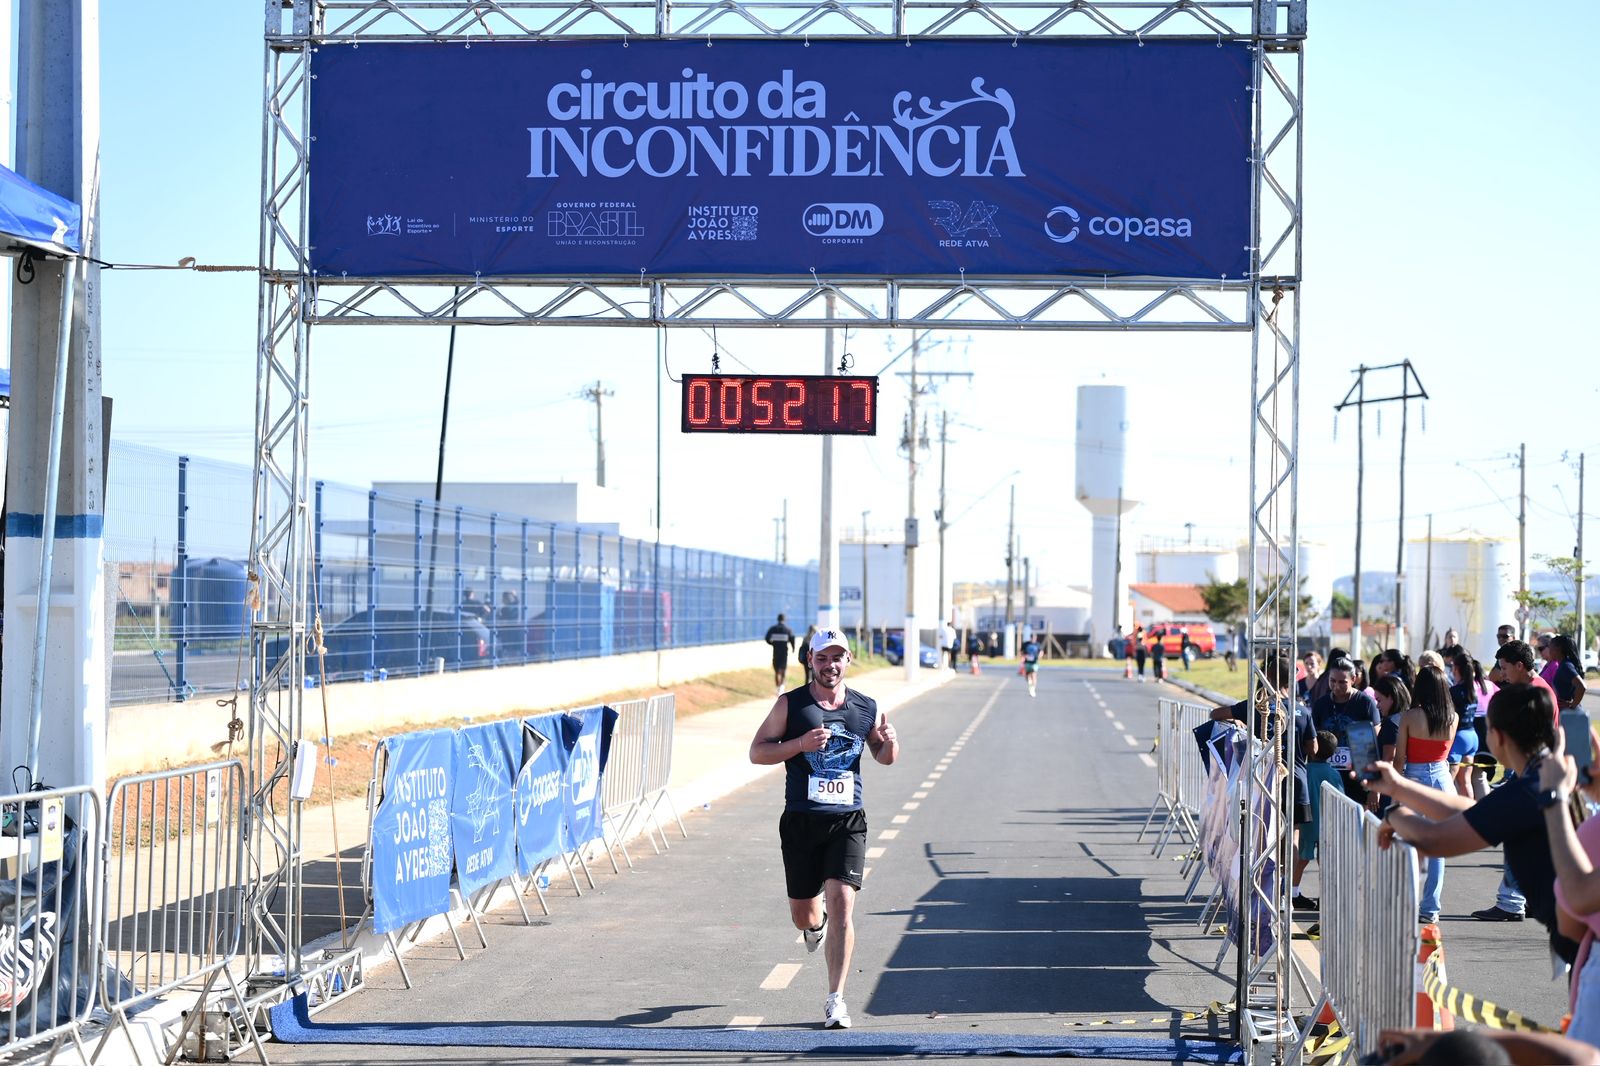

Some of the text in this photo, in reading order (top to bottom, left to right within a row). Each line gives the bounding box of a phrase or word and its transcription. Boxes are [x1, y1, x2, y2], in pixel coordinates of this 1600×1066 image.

[547, 68, 826, 120] circuito da
[526, 110, 1026, 178] INCONFIDÊNCIA
[687, 211, 729, 229] JOÃO
[688, 205, 759, 217] INSTITUTO
[835, 209, 872, 230] DM
[495, 225, 534, 233] ESPORTE
[547, 211, 645, 237] BRASIL
[687, 230, 731, 241] AYRES
[1088, 215, 1193, 242] copasa
[584, 239, 637, 247] RECONSTRUÇÃO
[939, 239, 990, 248] REDE ATVA
[832, 382, 871, 424] 17
[393, 766, 446, 805] INSTITUTO
[818, 780, 844, 793] 500
[393, 800, 427, 845] JOÃO
[395, 846, 430, 885] AYRES
